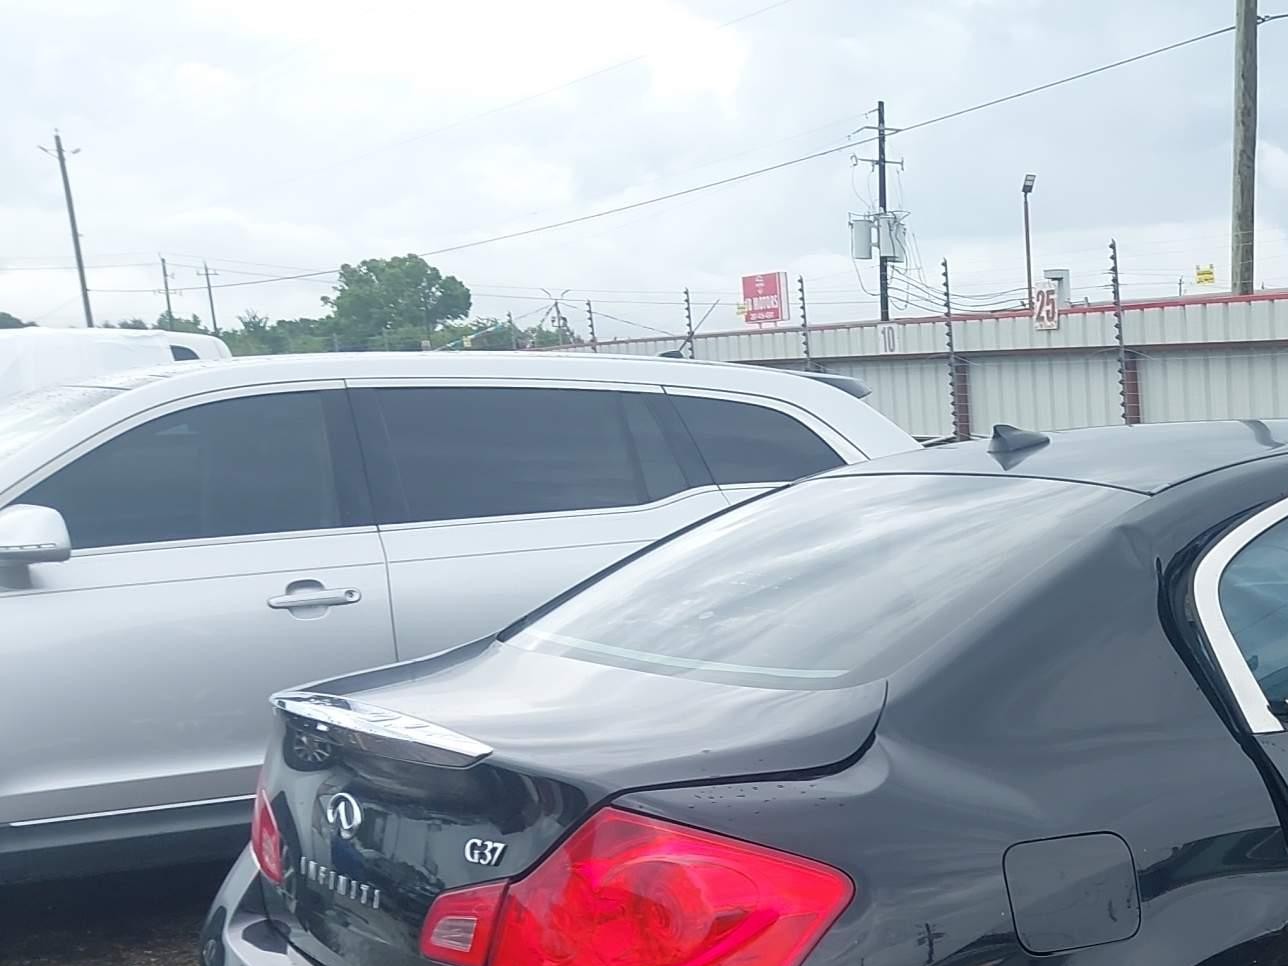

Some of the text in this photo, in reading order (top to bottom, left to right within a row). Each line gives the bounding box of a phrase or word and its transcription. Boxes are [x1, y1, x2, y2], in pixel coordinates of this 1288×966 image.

[1035, 289, 1056, 321] 25
[881, 325, 896, 352] 10
[465, 839, 505, 865] G37
[301, 855, 380, 909] INFINITI
